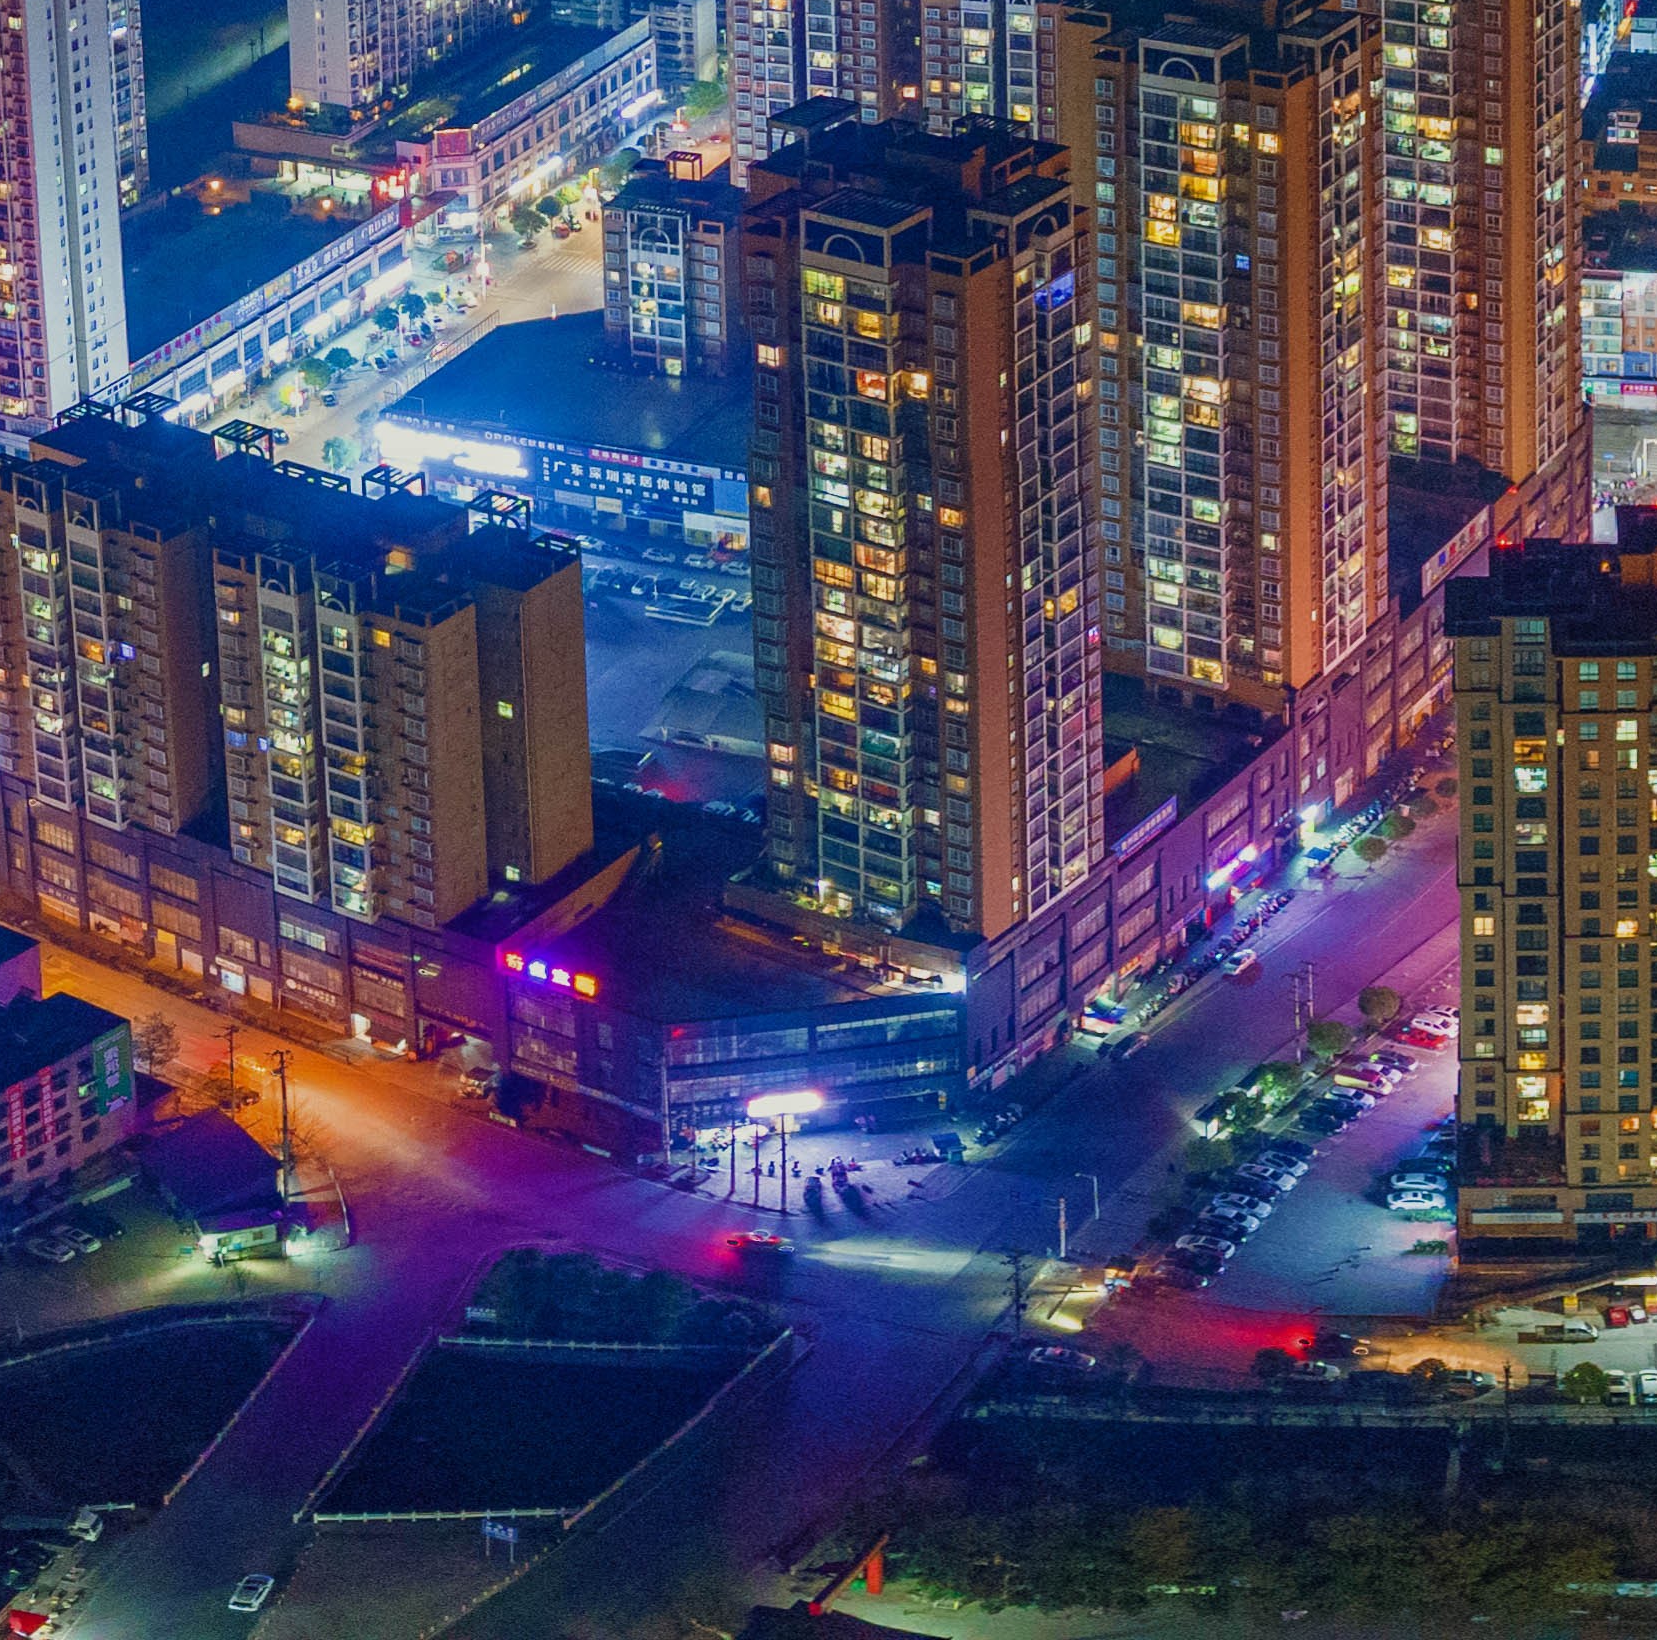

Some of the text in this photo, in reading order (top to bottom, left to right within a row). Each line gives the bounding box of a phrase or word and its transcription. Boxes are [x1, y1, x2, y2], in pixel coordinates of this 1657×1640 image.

[548, 460, 706, 497] 广东深圳家居体验馆
